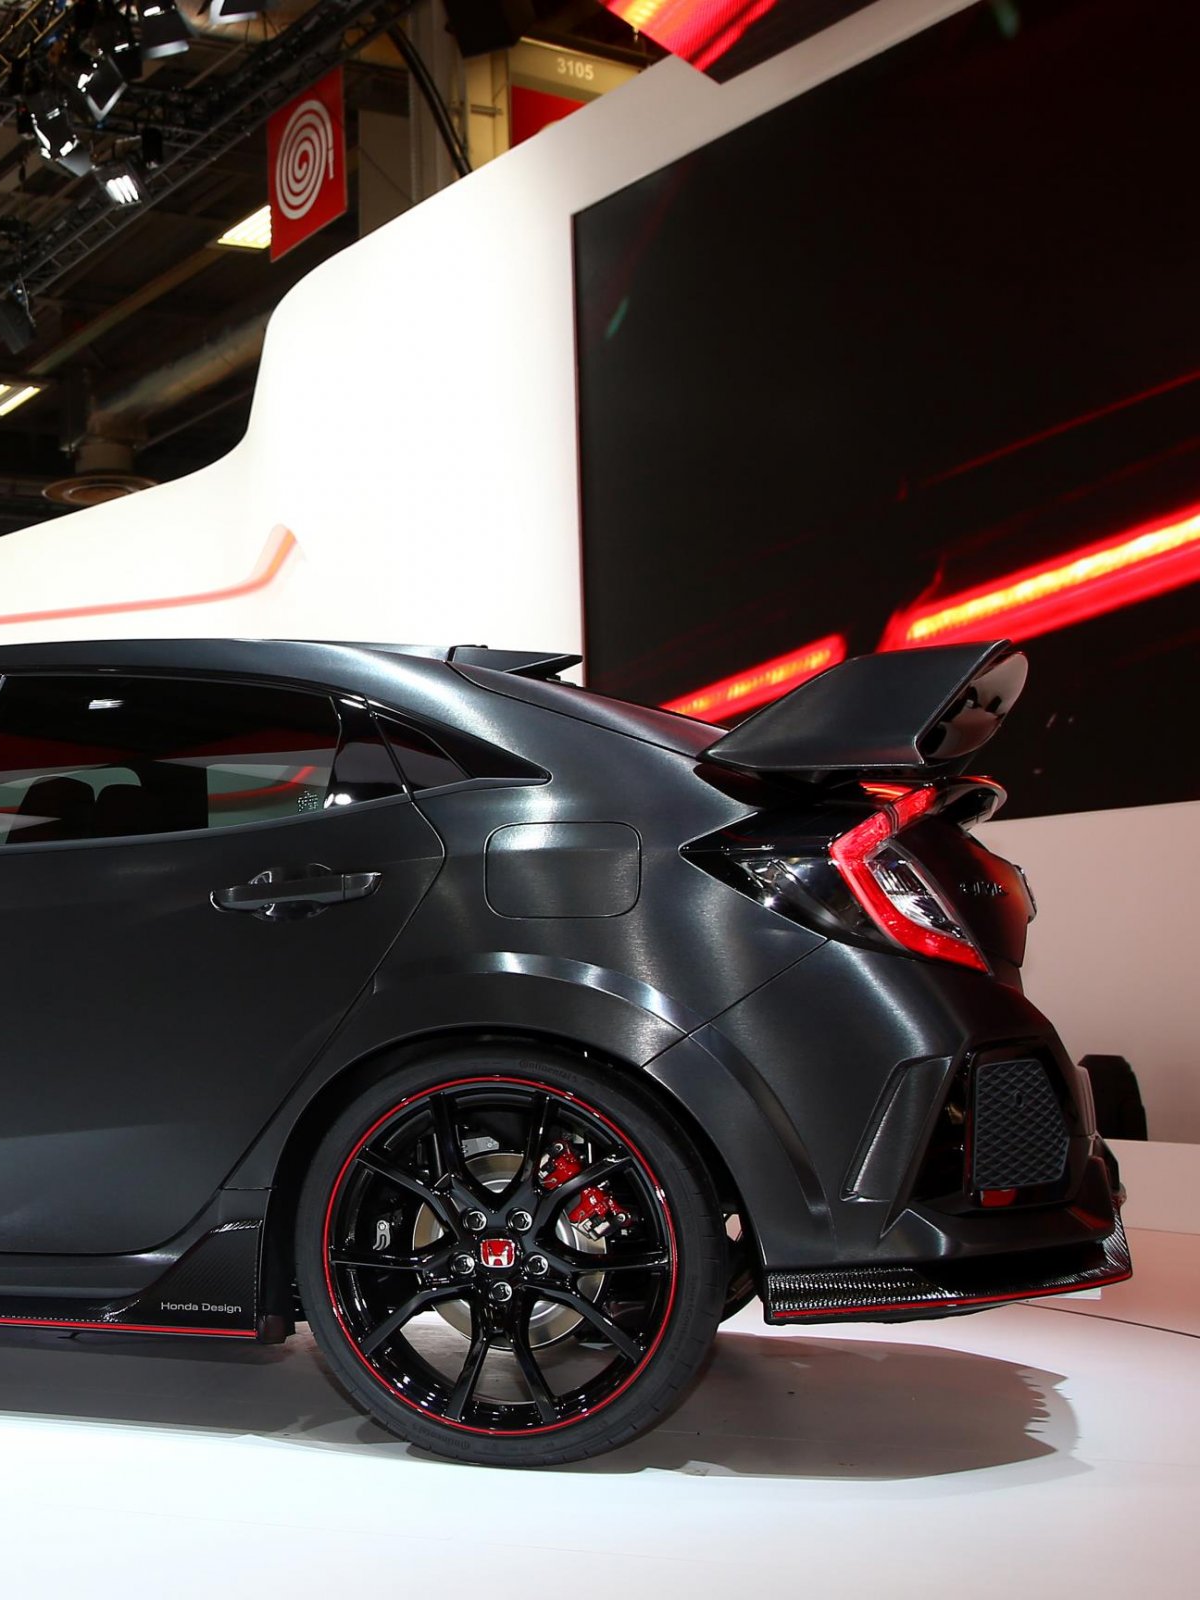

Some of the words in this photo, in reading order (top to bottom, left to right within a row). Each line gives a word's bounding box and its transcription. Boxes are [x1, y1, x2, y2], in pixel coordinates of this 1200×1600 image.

[557, 57, 595, 81] 3105
[160, 1301, 199, 1311] Honda
[201, 1303, 242, 1314] Design
